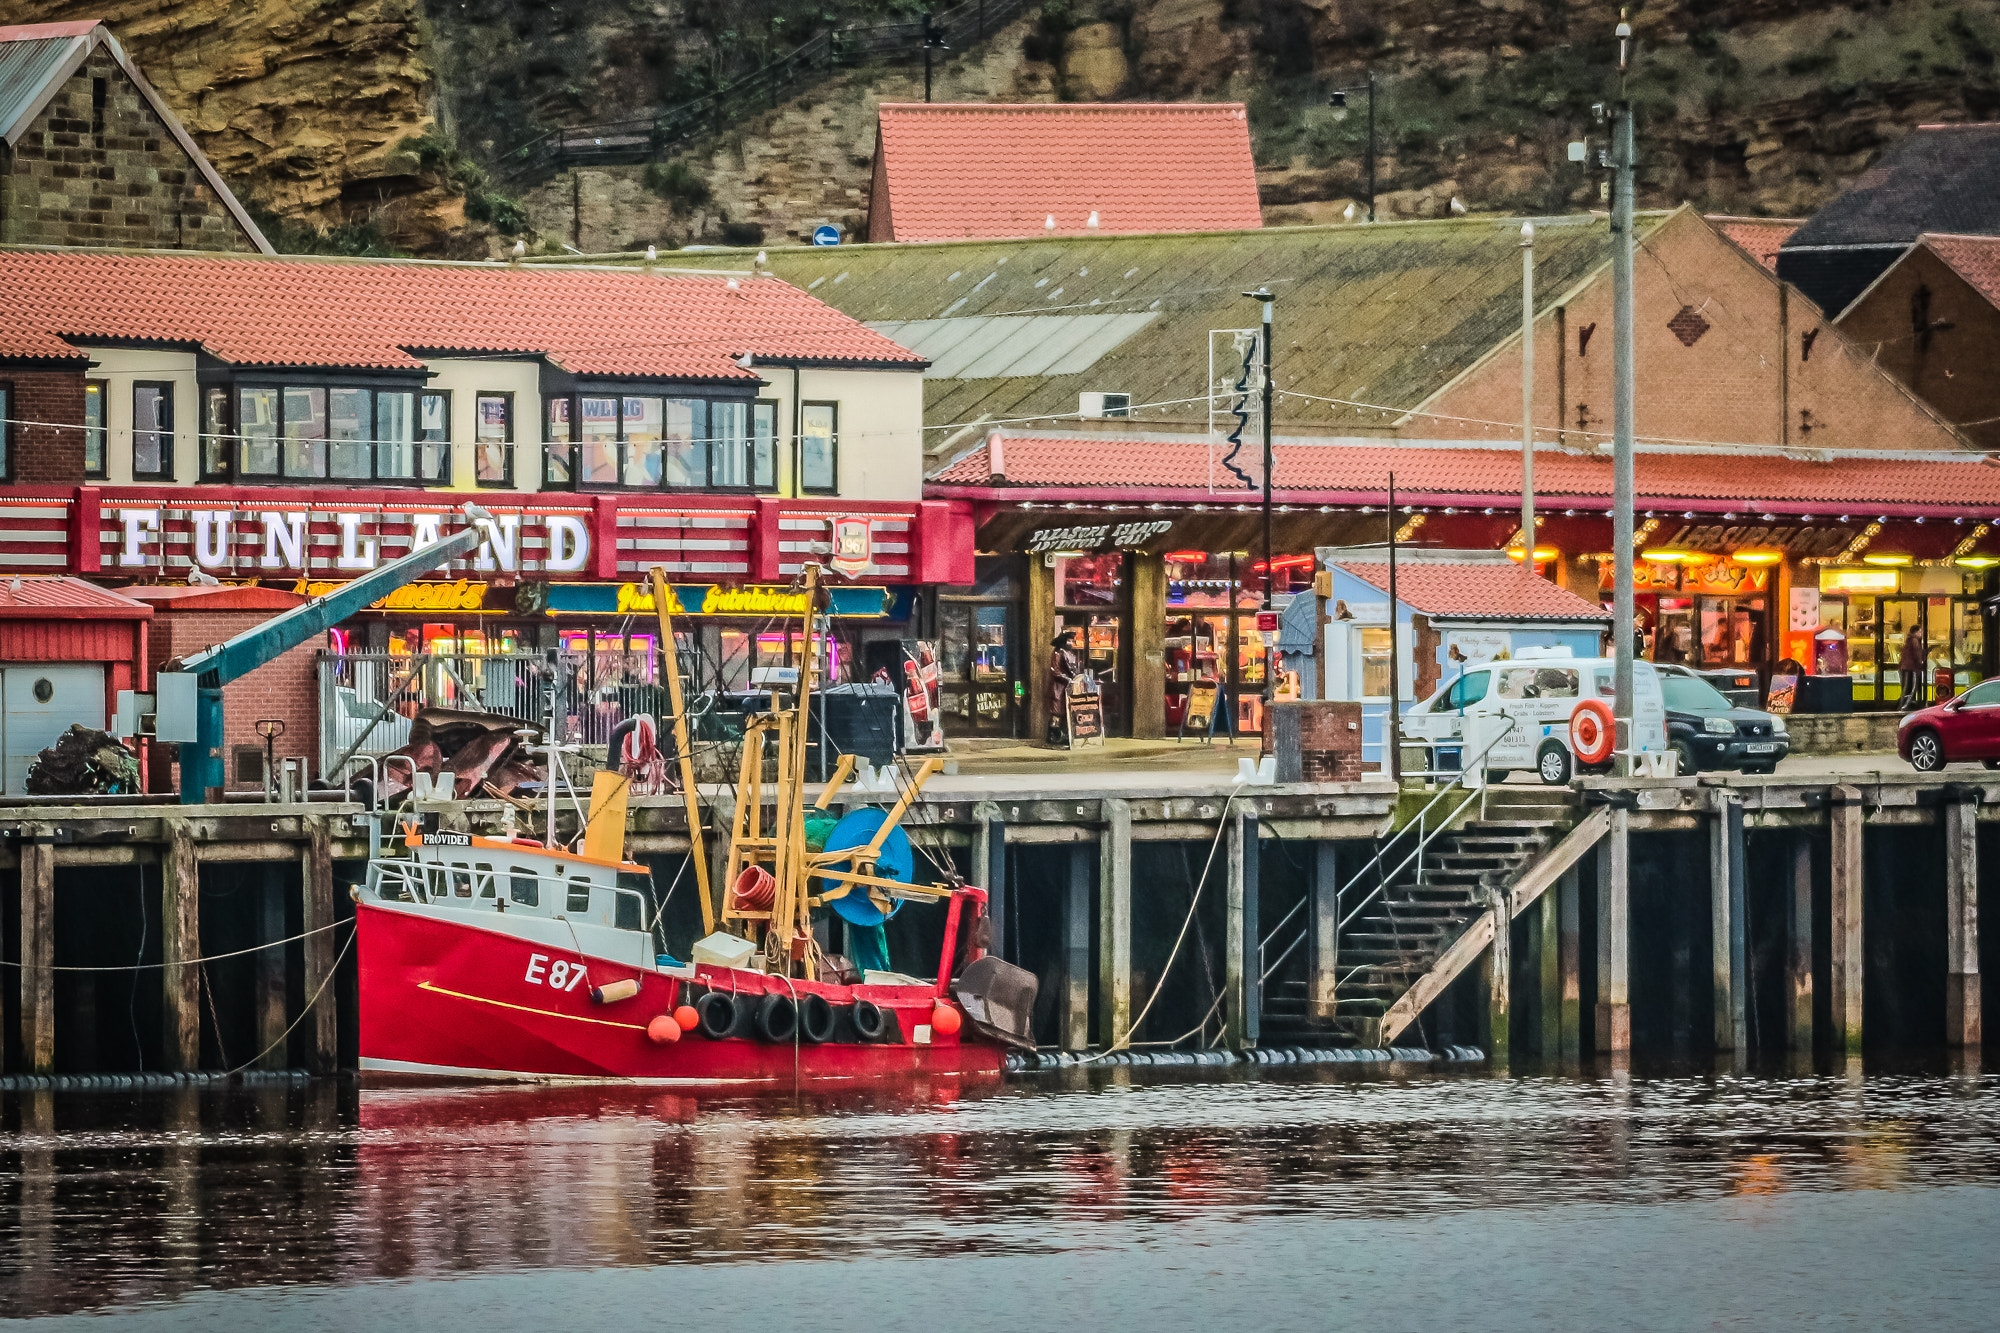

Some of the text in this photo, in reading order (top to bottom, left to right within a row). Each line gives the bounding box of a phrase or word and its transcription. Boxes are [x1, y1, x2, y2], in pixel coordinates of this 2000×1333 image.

[561, 400, 641, 417] BWLING
[1030, 520, 1173, 542] PLEASURE ISLAND
[120, 509, 588, 571] FUNLAND
[840, 538, 866, 553] 1967
[293, 577, 488, 609] Amments
[1505, 726, 1524, 734] 1947
[1503, 735, 1526, 743] 601313
[423, 834, 470, 845] PROVIDER
[524, 953, 588, 992] E 87
